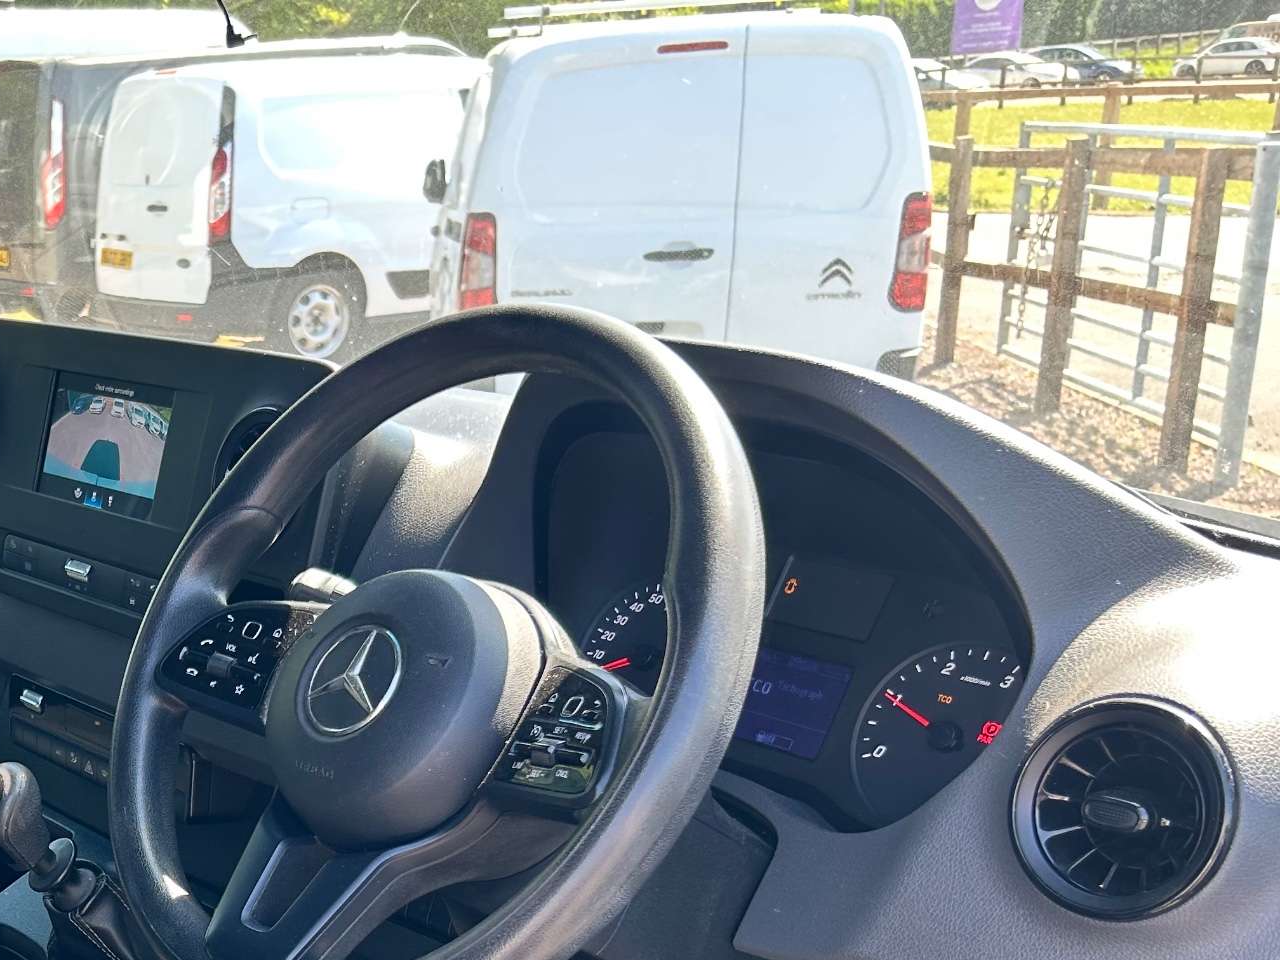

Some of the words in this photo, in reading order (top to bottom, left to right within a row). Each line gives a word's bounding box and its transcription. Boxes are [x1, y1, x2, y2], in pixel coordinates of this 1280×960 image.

[648, 593, 664, 605] 50
[629, 602, 644, 613] 40
[613, 614, 628, 626] 30
[600, 630, 616, 641] 20
[593, 649, 605, 660] 10
[940, 662, 956, 676] 2
[751, 679, 773, 695] CO
[999, 675, 1015, 689] 3
[937, 693, 952, 704] TCO
[872, 744, 887, 758] 0
